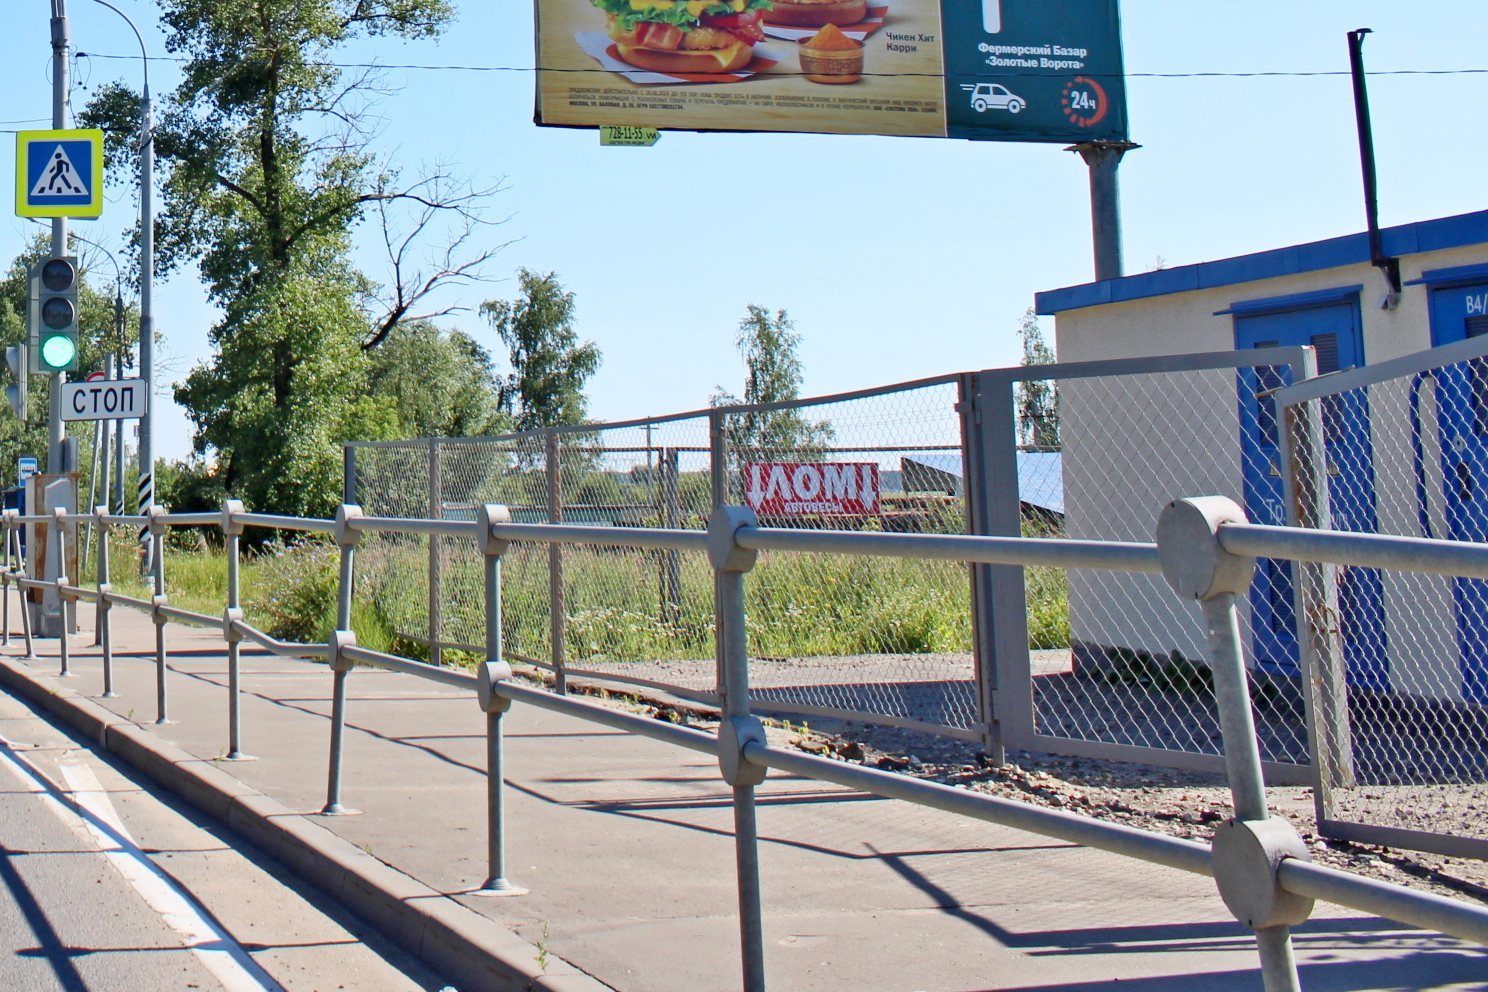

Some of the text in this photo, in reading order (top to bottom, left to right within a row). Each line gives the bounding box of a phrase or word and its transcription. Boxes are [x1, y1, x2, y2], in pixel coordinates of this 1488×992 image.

[886, 32, 935, 42] Чикен Хит
[887, 43, 917, 53] Карри
[978, 42, 1087, 58] Фермерский Базар
[985, 56, 1084, 70] «Золотые Ворота»
[73, 387, 133, 414] СТОП
[765, 464, 856, 500] ЛОМ
